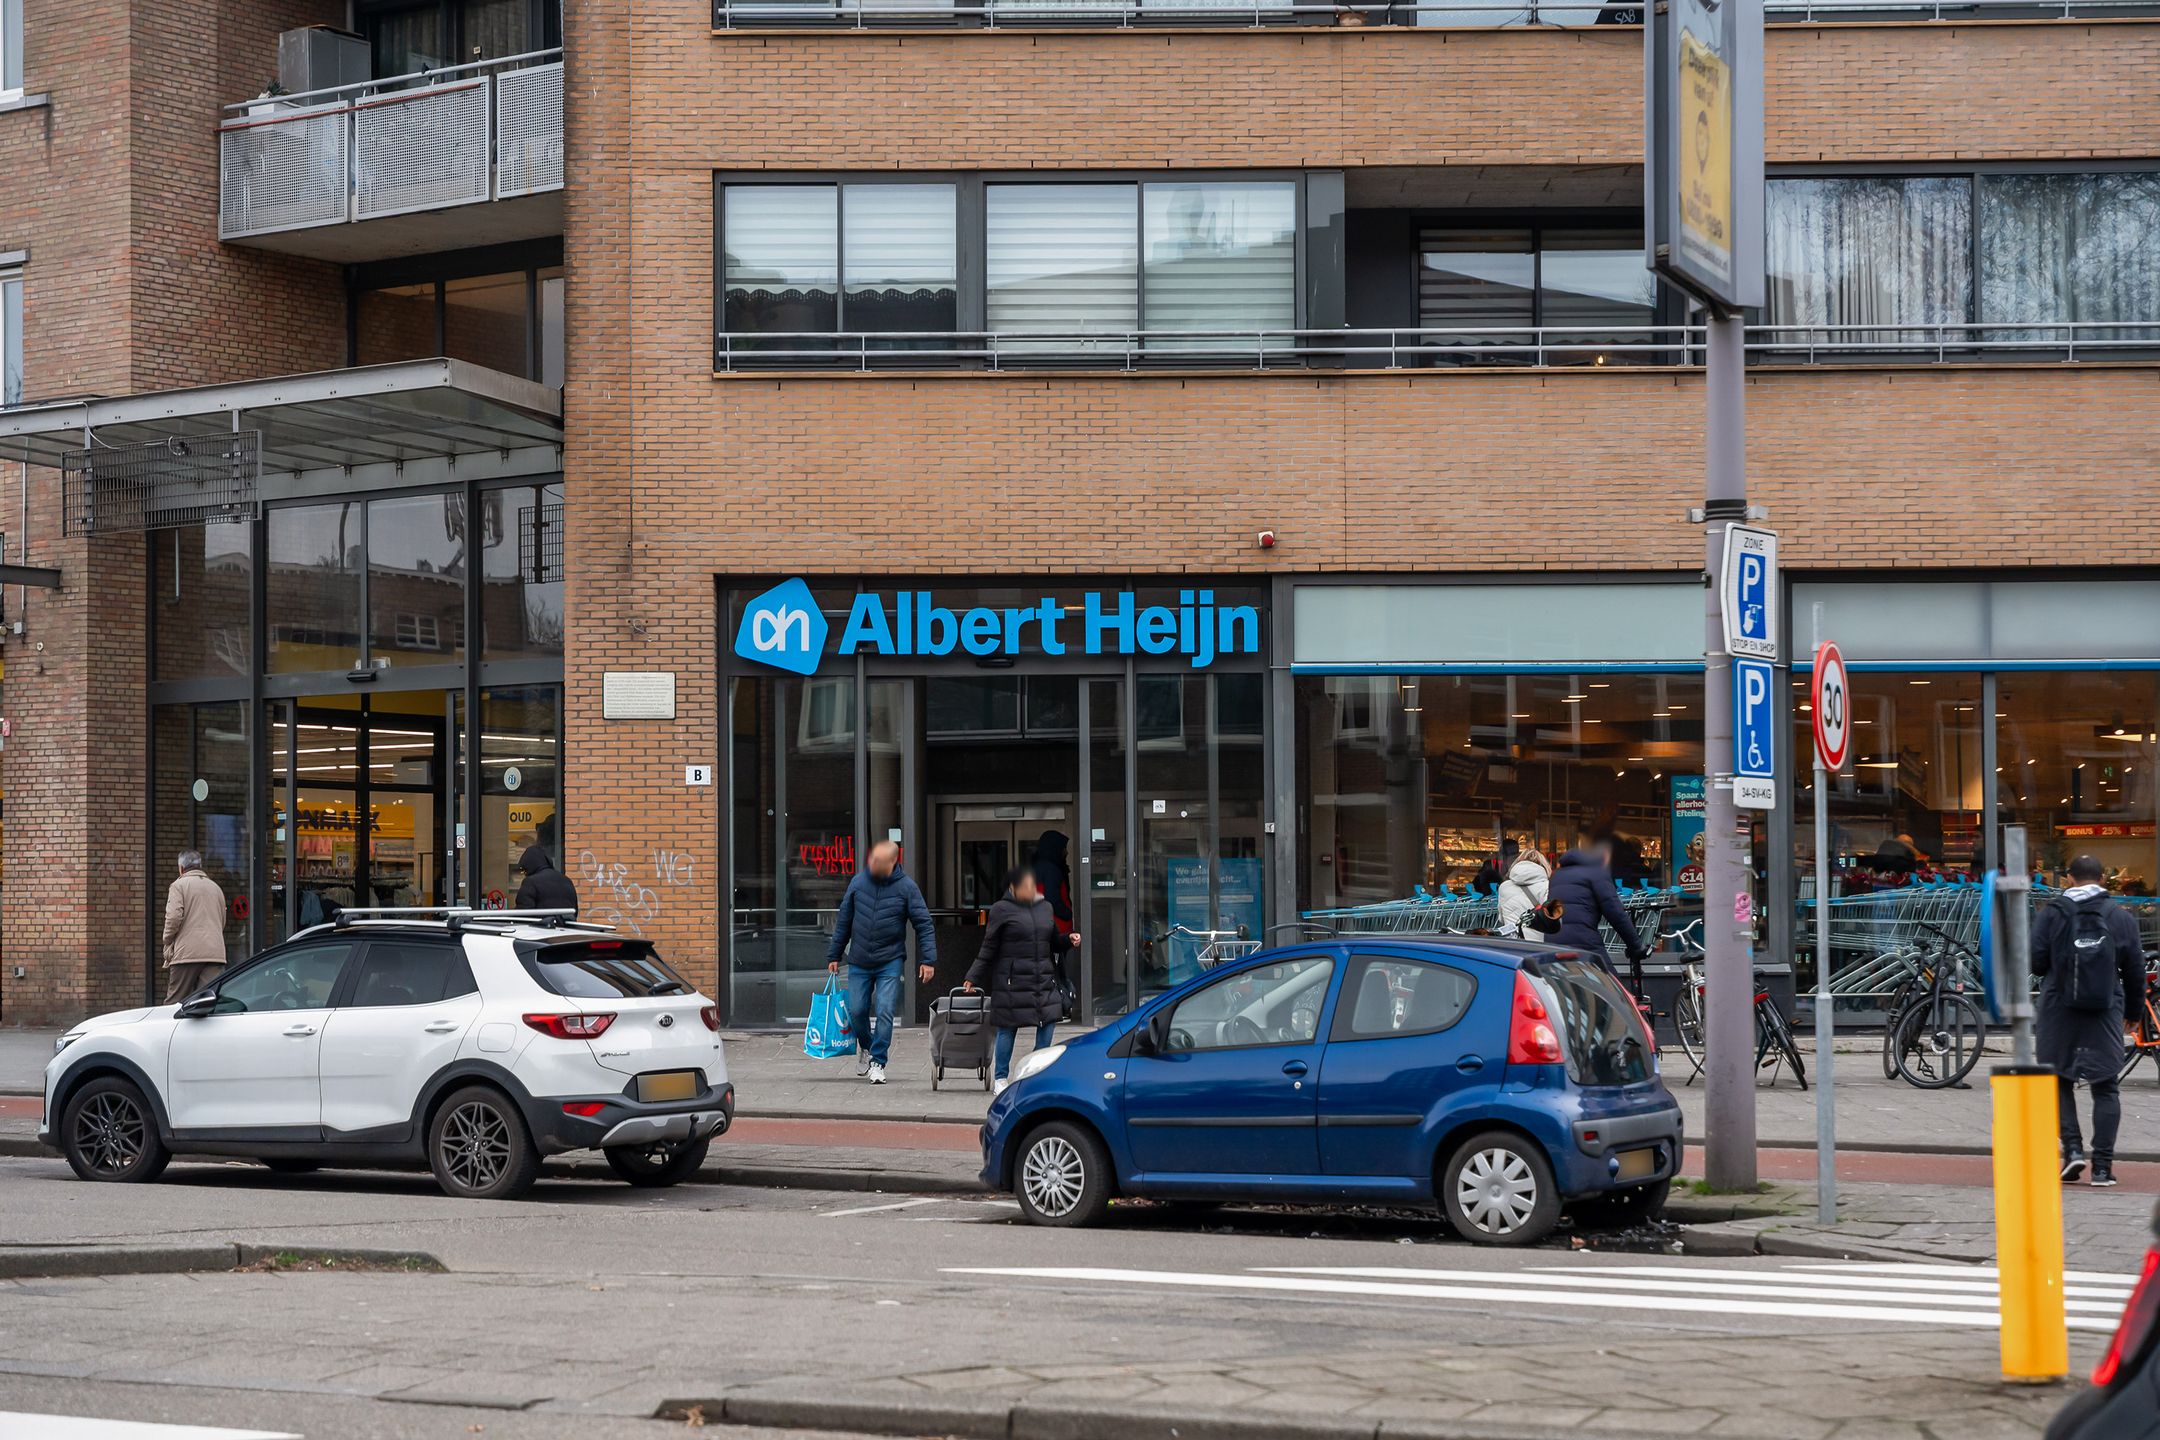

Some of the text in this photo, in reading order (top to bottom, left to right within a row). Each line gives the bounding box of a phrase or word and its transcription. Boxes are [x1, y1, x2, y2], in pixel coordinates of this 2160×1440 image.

[1743, 537, 1764, 551] ZONE
[1743, 557, 1761, 602] P
[838, 589, 1259, 668] Albert Heijn
[1731, 638, 1775, 653] STOP EN SHOP
[1745, 669, 1765, 726] P
[1824, 682, 1842, 730] 30
[694, 769, 703, 781] B
[1676, 791, 1699, 800] Spaar
[1741, 786, 1772, 800] 34-SV-KG
[2066, 827, 2093, 836] BONUS
[2101, 826, 2122, 836] 25%
[1175, 866, 1189, 875] We
[1680, 872, 1704, 883] €14
